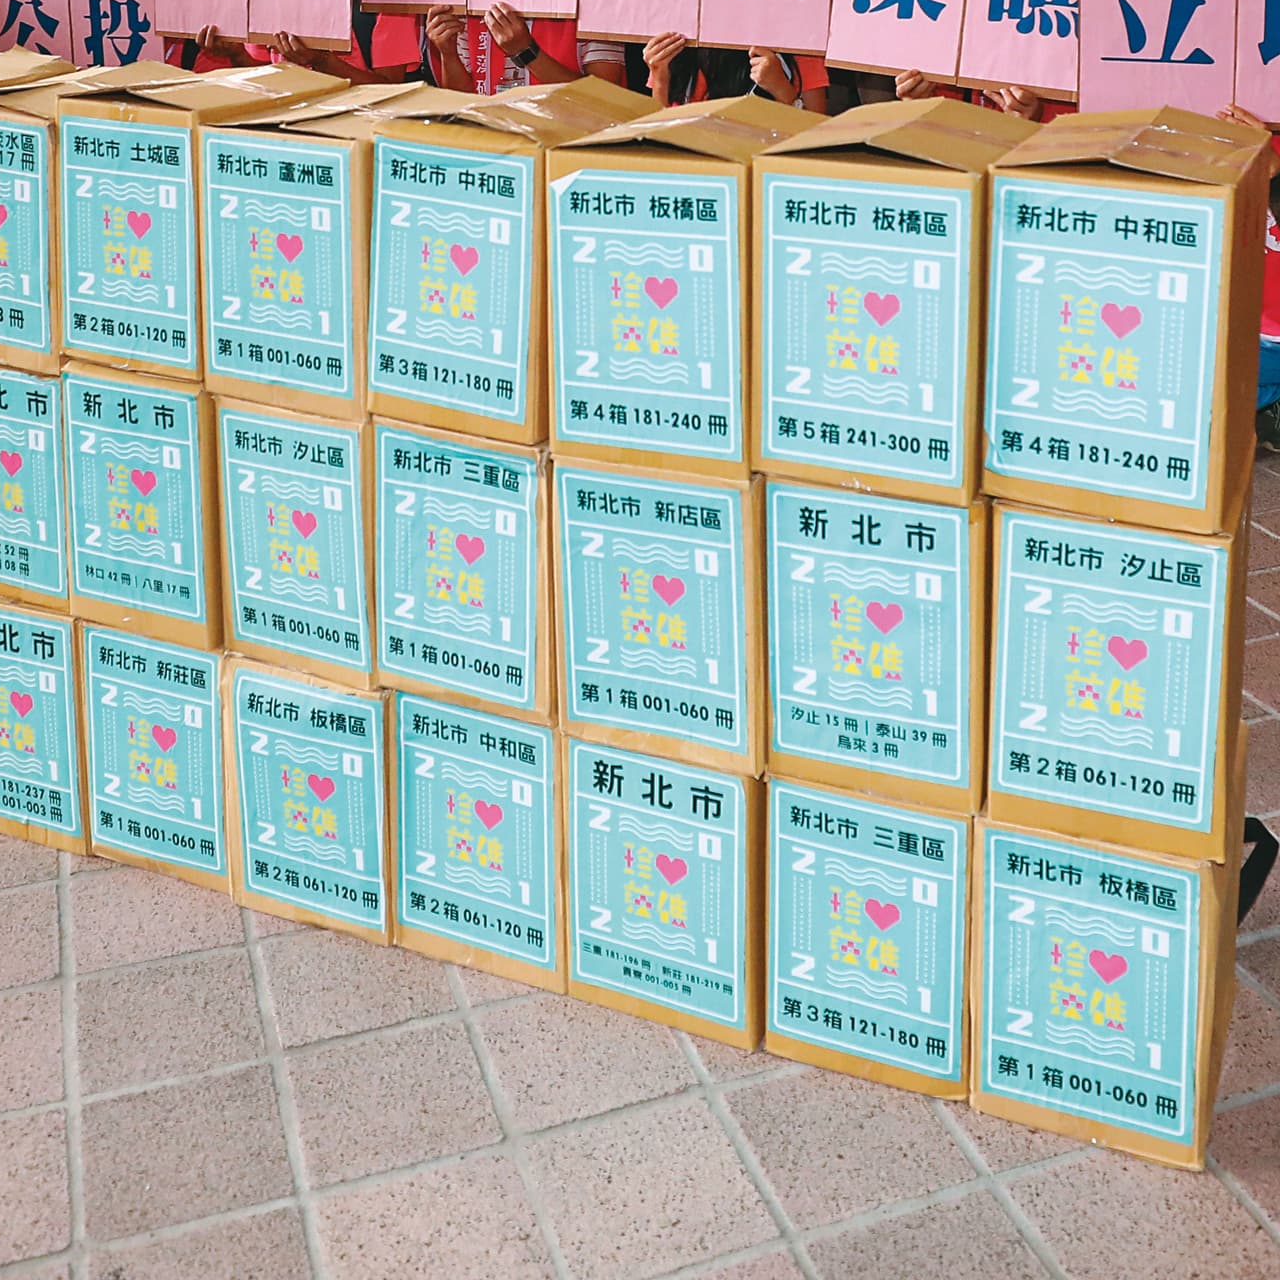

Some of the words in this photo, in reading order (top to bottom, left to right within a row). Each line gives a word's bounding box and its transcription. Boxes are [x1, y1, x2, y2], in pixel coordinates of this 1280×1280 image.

[21, 152, 35, 172] 冊
[74, 135, 120, 159] 新北市
[130, 142, 180, 166] 土城區
[217, 153, 268, 178] 新北市
[279, 161, 334, 187] 蘆洲區
[391, 159, 446, 186] 新北市
[458, 170, 515, 198] 中和區
[570, 191, 635, 216] 新北市
[649, 195, 717, 222] 板橋區
[785, 199, 857, 227] 新北市
[872, 207, 947, 237] 板橋區
[1017, 204, 1097, 235] 新北市
[1115, 215, 1198, 247] 中和區
[9, 308, 25, 329] 冊
[73, 313, 115, 337] 第2箱
[118, 322, 168, 343] 061-120
[171, 329, 186, 349] 冊
[218, 338, 263, 363] 第1箱
[267, 348, 322, 371] 001-060
[326, 357, 342, 377] 冊
[379, 353, 428, 382] 第3箱
[434, 366, 491, 392] 121-180
[496, 378, 513, 400] 冊
[83, 391, 175, 430] 新北市
[570, 399, 627, 425] 第4箱
[634, 408, 701, 430] 181-240
[708, 414, 728, 436] 冊
[235, 429, 283, 456] 新北市
[293, 441, 344, 468] 汐止區
[778, 415, 840, 445] 第5箱
[847, 427, 921, 454] 241-300
[928, 438, 949, 461] 冊
[1002, 429, 1069, 461] 第4箱
[1079, 443, 1158, 472] 181-240
[1166, 456, 1190, 481] 冊
[393, 448, 452, 476] 新北市
[463, 461, 521, 490] 三重區
[577, 489, 641, 517] 新北市
[655, 500, 721, 530] 新店區
[799, 506, 936, 553] 新北市
[1025, 537, 1103, 571] 新北市
[1120, 553, 1202, 587] 汐止區
[243, 606, 286, 633] 第1箱
[289, 619, 340, 644] 001-060
[344, 631, 360, 651] 冊
[99, 646, 147, 673] 新北市
[156, 660, 206, 689] 新莊區
[389, 635, 438, 665] 第1箱
[441, 650, 500, 678] 001-060
[506, 665, 523, 687] 冊
[247, 692, 300, 722] 新北市
[310, 708, 366, 737] 板橋區
[581, 682, 638, 710] 第1箱
[642, 694, 709, 721] 001-060
[715, 708, 734, 730] 冊
[412, 713, 468, 744] 新北市
[480, 732, 536, 765] 中和區
[1, 779, 45, 801] 181-237
[48, 790, 62, 807] 冊
[593, 759, 724, 820] 新北市
[1009, 751, 1077, 783] 第2箱
[1083, 767, 1164, 796] 061-120
[1172, 782, 1195, 806] 冊
[2, 792, 47, 817] 001-003
[50, 806, 63, 823] 冊
[100, 810, 141, 838] 第1箱
[144, 825, 196, 850] 001-060
[200, 839, 215, 857] 冊
[790, 805, 859, 839] 新北市
[873, 826, 945, 861] 三重區
[254, 859, 300, 888] 第2箱
[303, 875, 358, 902] 061-120
[362, 891, 379, 910] 冊
[1007, 852, 1082, 886] 新北市
[1099, 872, 1177, 911] 板橋區
[410, 891, 459, 922] 第2箱
[463, 908, 522, 938] 061-120
[526, 927, 544, 948] 冊
[783, 996, 842, 1030] 第3箱
[849, 1016, 919, 1049] 121-180
[925, 1036, 947, 1058] 冊
[998, 1055, 1063, 1089] 第1箱
[1069, 1074, 1148, 1108] 001-060
[1155, 1095, 1178, 1119] 冊
